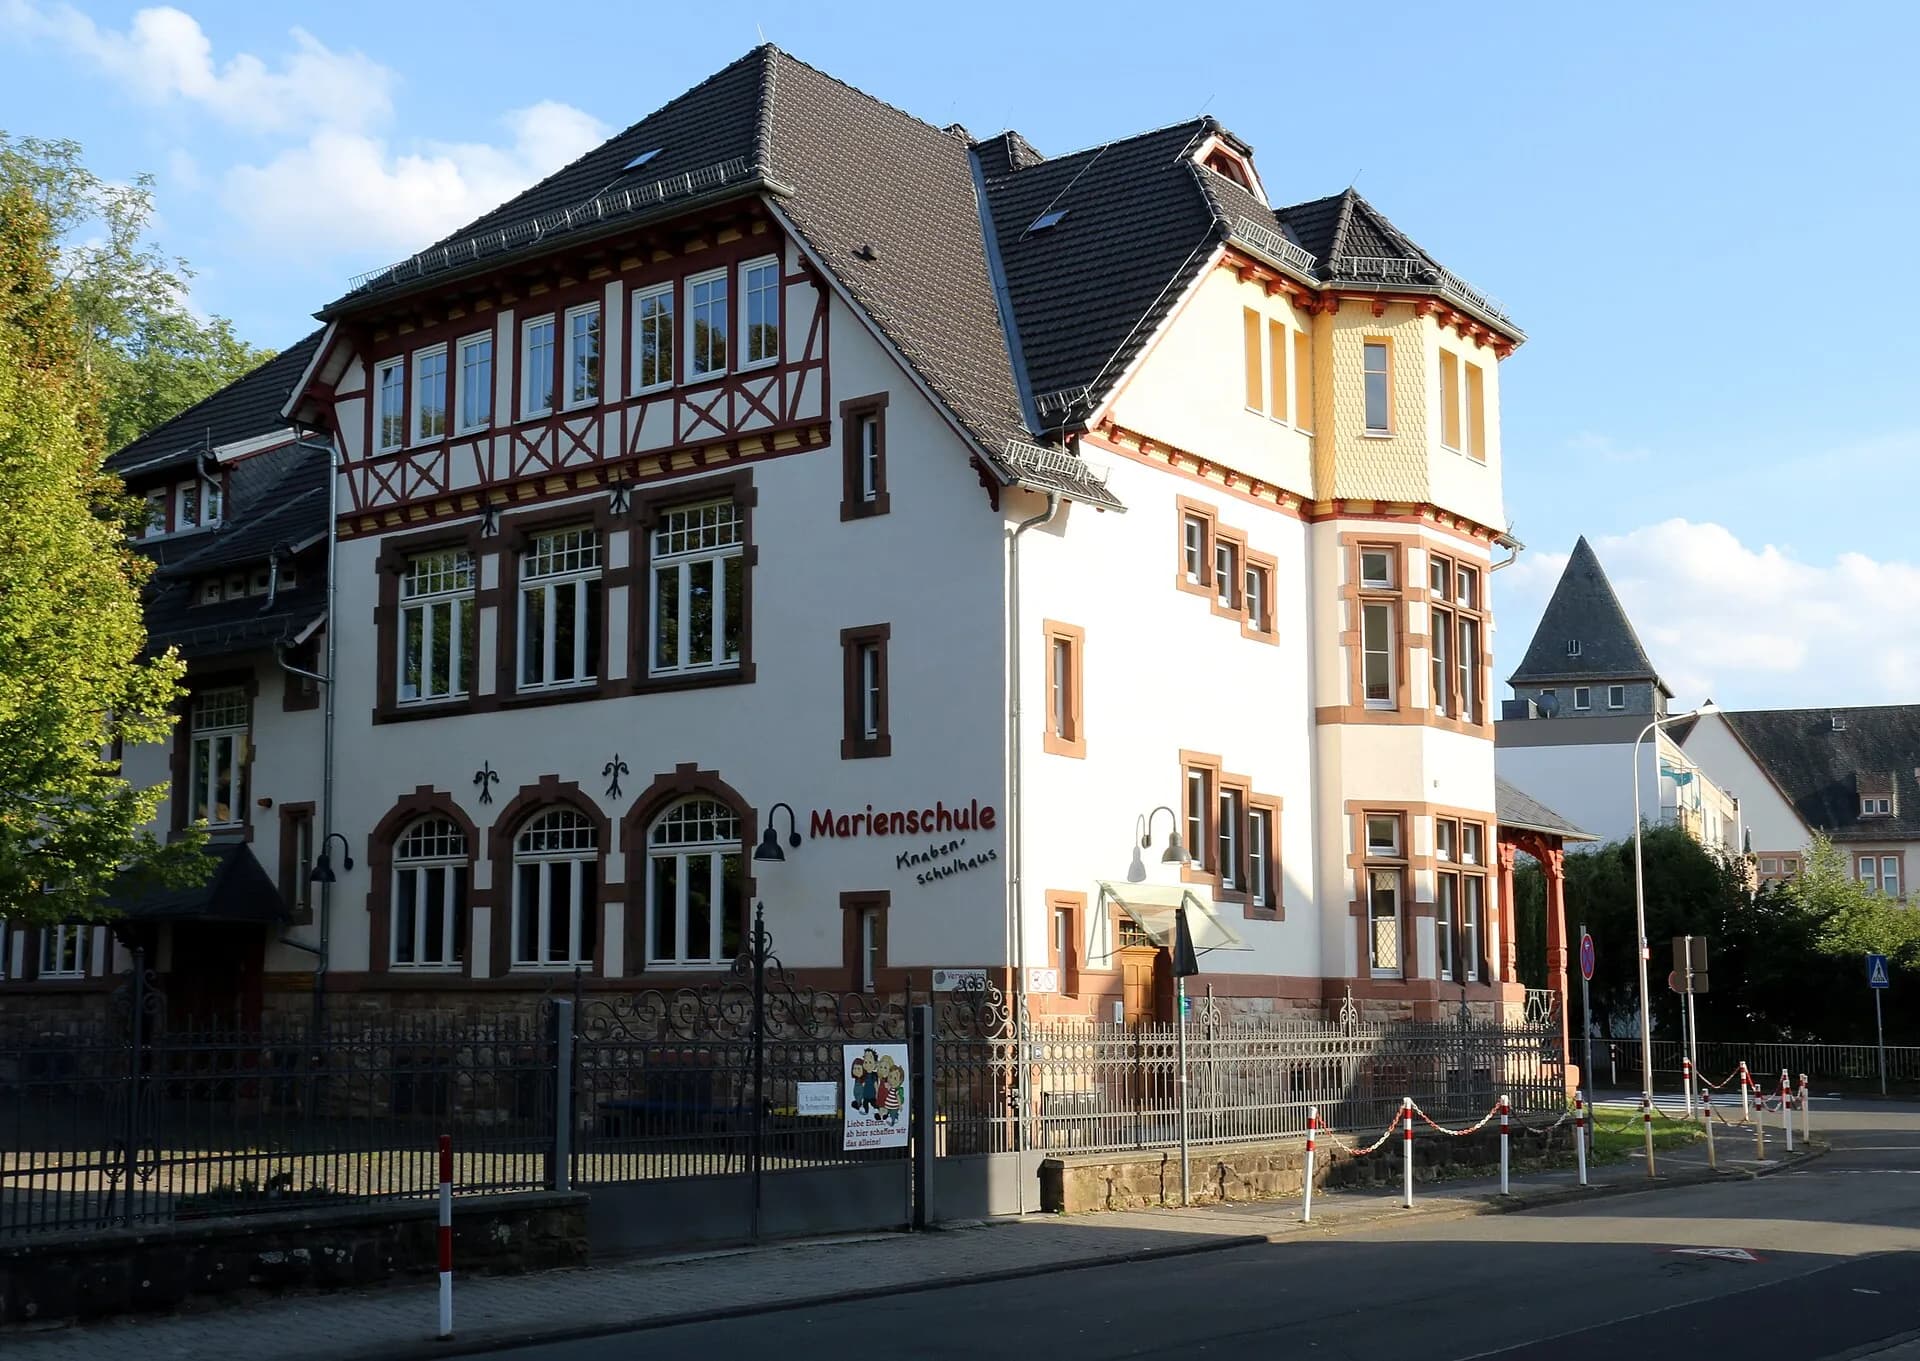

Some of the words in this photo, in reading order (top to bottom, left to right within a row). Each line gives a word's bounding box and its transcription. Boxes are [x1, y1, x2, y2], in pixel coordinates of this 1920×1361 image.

[810, 799, 996, 839] Marienschule
[896, 838, 966, 871] Knaben-
[916, 849, 998, 885] schulhaus
[846, 1130, 854, 1138] ab
[855, 1129, 868, 1137] hier
[869, 1128, 895, 1137] schaffen
[895, 1126, 907, 1134] wir
[847, 1119, 865, 1129] Liebe
[846, 1138, 857, 1147] das
